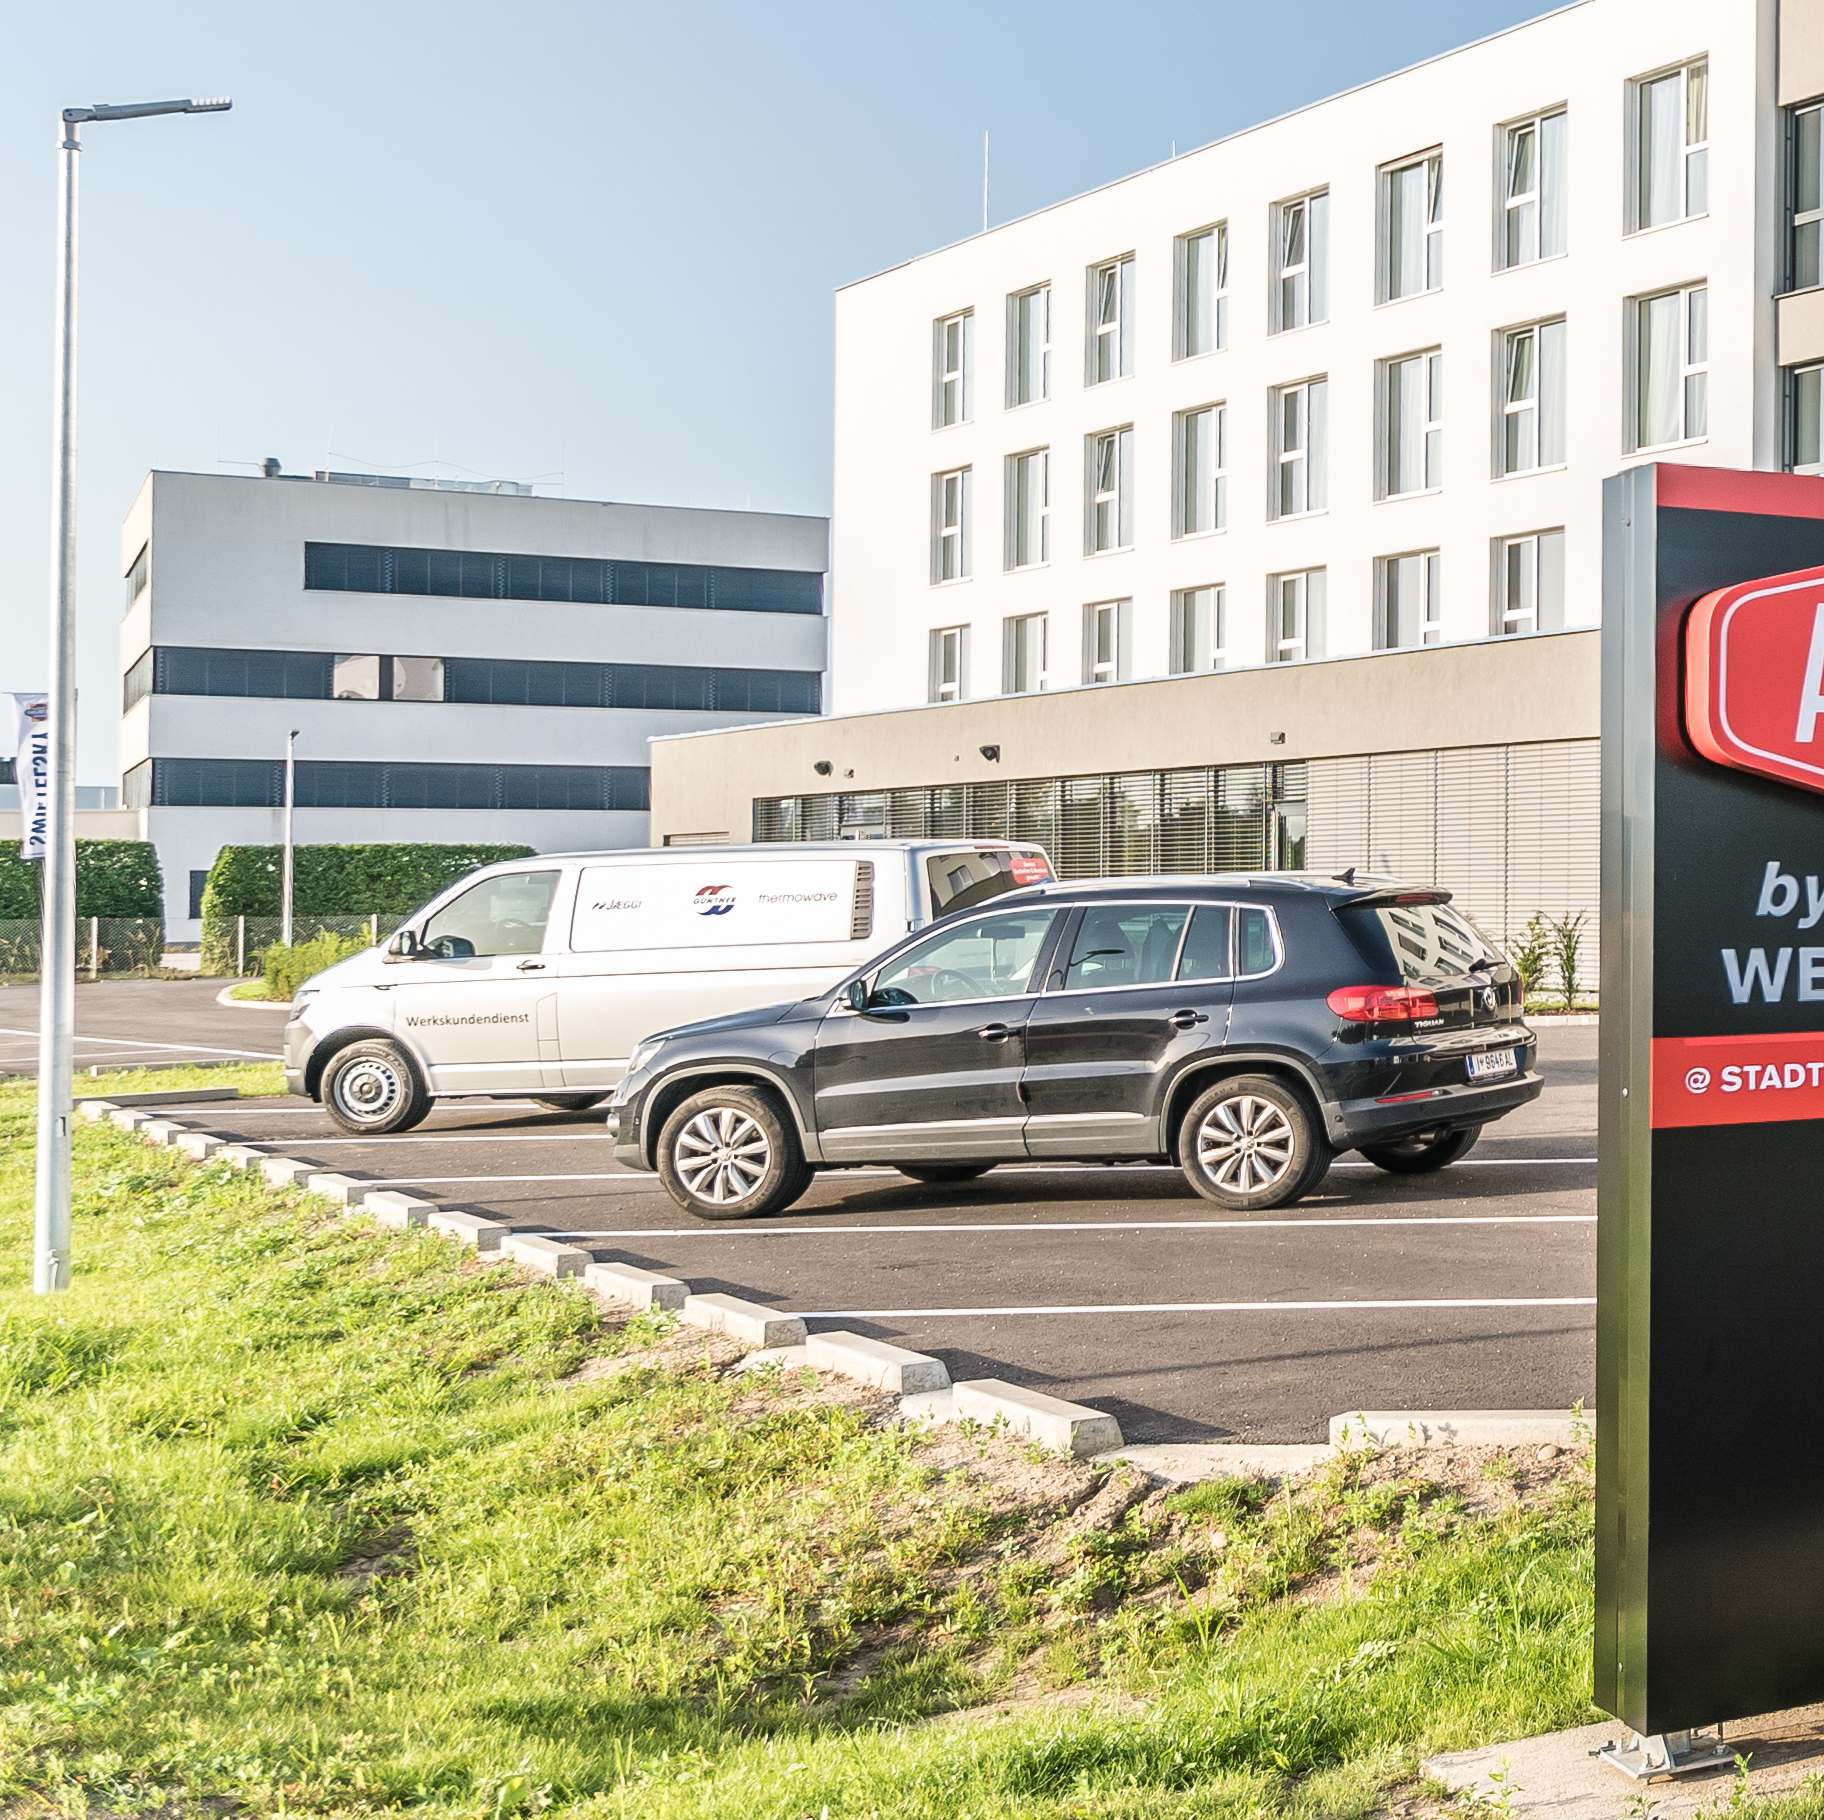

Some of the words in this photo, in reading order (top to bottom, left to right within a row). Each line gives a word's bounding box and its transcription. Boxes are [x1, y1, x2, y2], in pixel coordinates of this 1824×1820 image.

[758, 892, 838, 904] thermowave
[405, 1012, 530, 1027] Werkskundendienst
[1685, 1067, 1711, 1094] @
